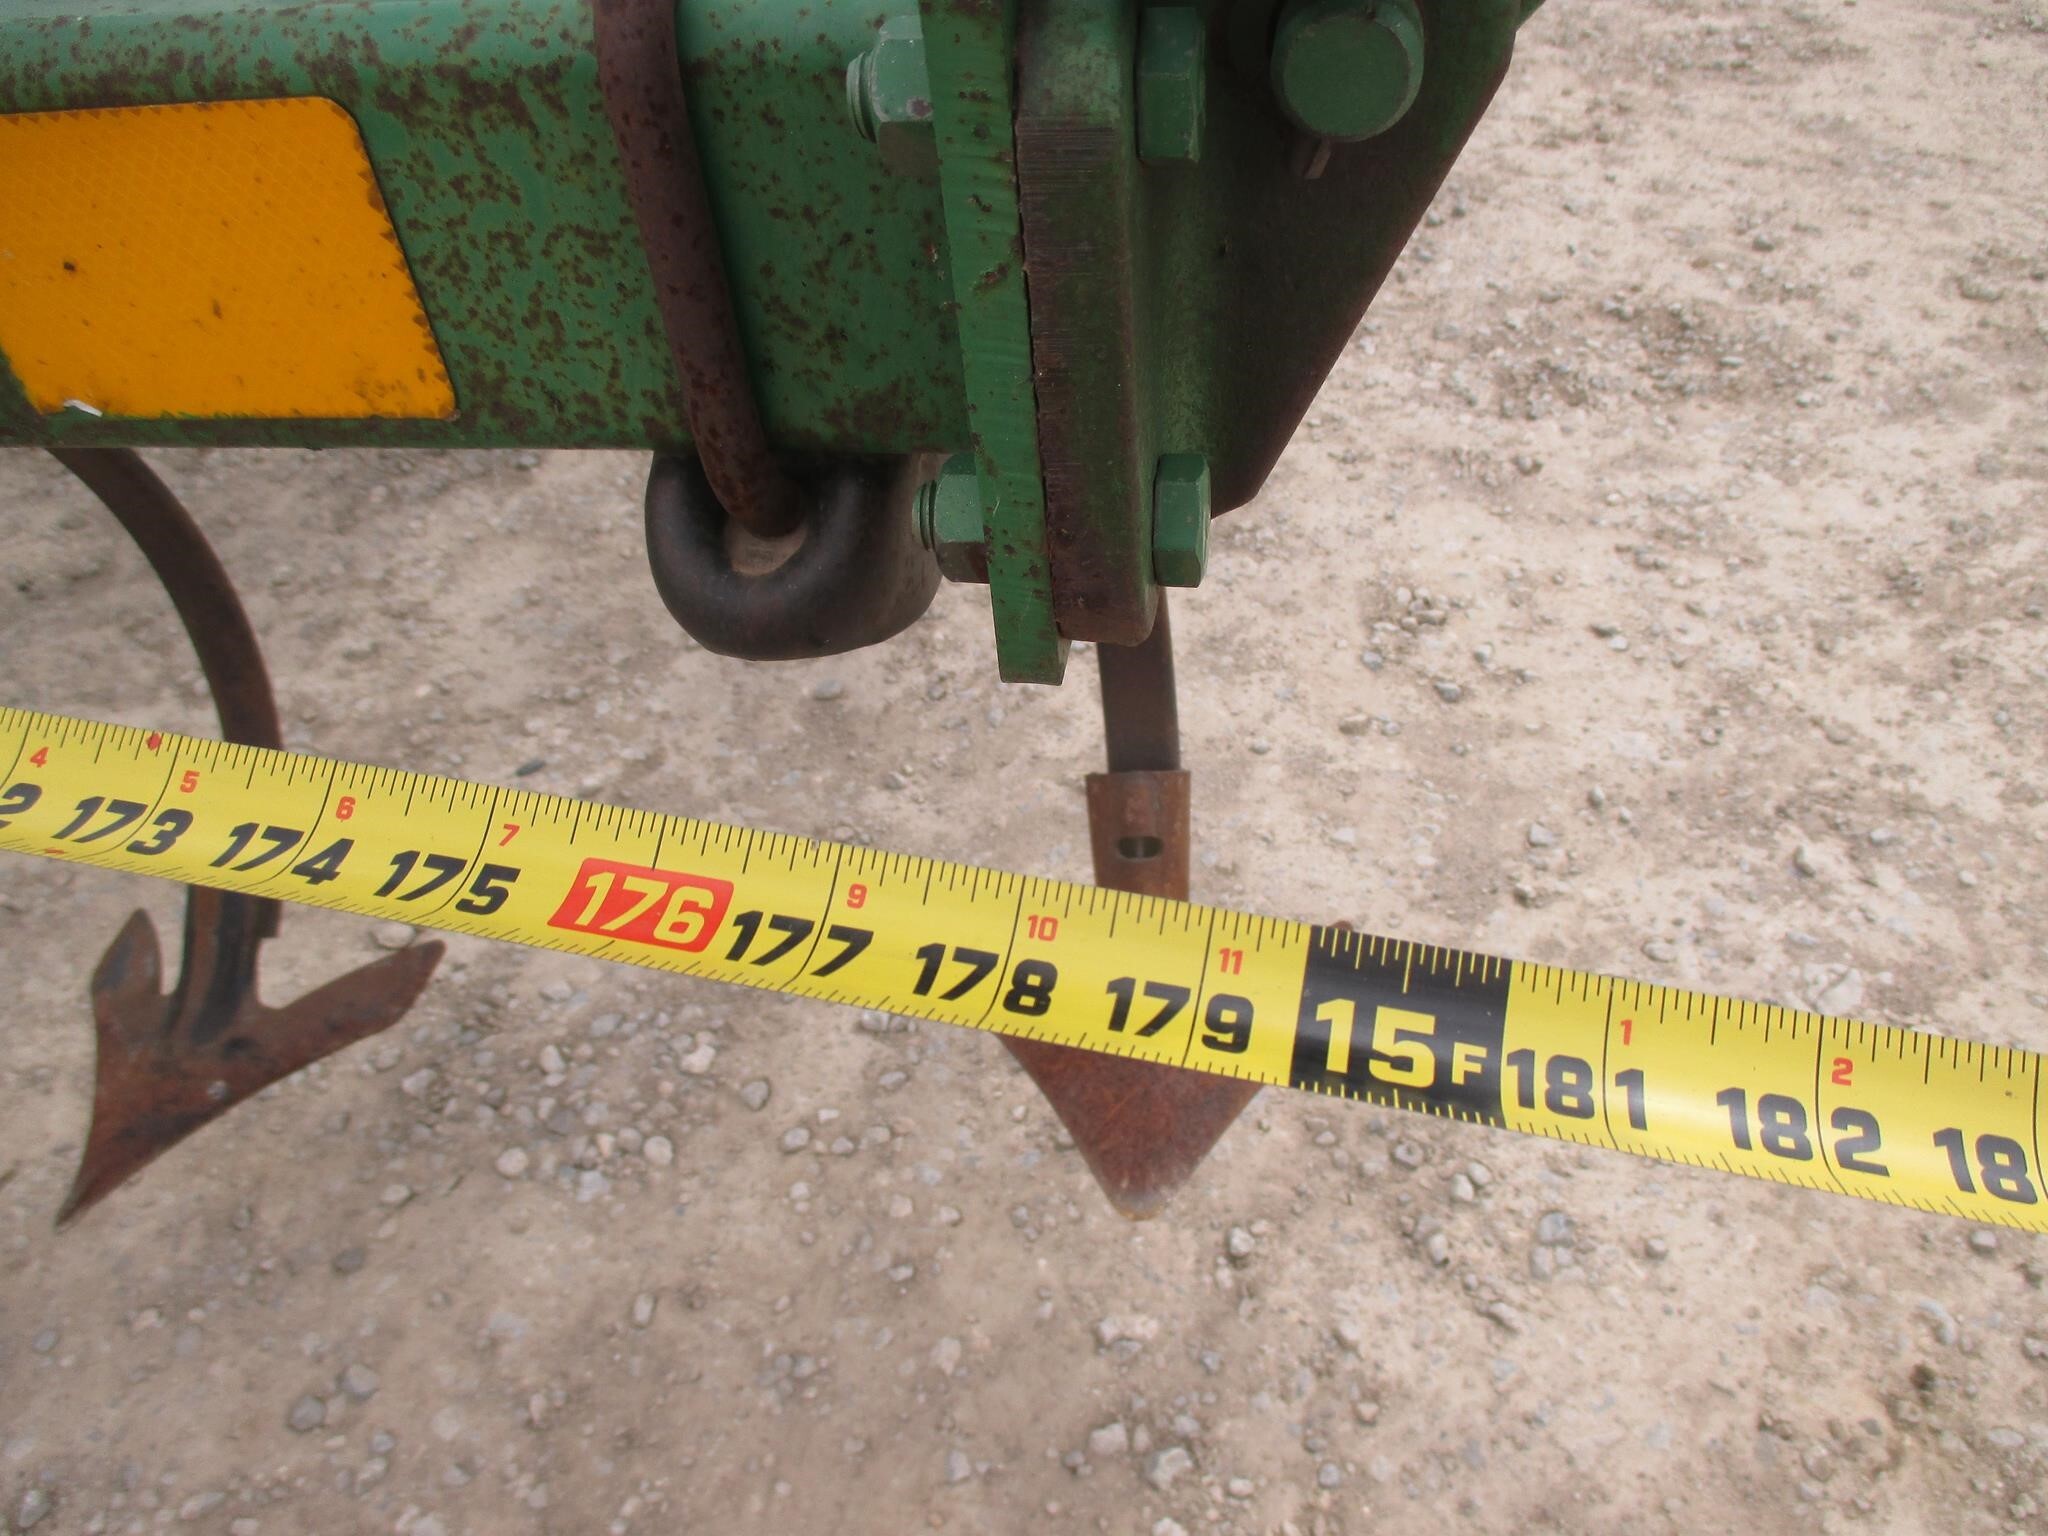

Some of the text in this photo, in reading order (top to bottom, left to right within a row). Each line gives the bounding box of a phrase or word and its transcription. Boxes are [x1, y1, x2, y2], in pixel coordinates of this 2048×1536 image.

[30, 747, 1854, 1087] 4 5 6 7 9 10 11 1 2
[50, 796, 194, 855] 173
[209, 822, 355, 885] 174
[373, 850, 521, 916] 175
[574, 871, 715, 945] 176
[725, 910, 874, 977] 177
[912, 943, 1059, 1017] 178
[1105, 976, 1255, 1054] 179
[1315, 998, 1488, 1088] 15F
[1506, 1048, 1648, 1131] 181
[1716, 1087, 1890, 1177] 182
